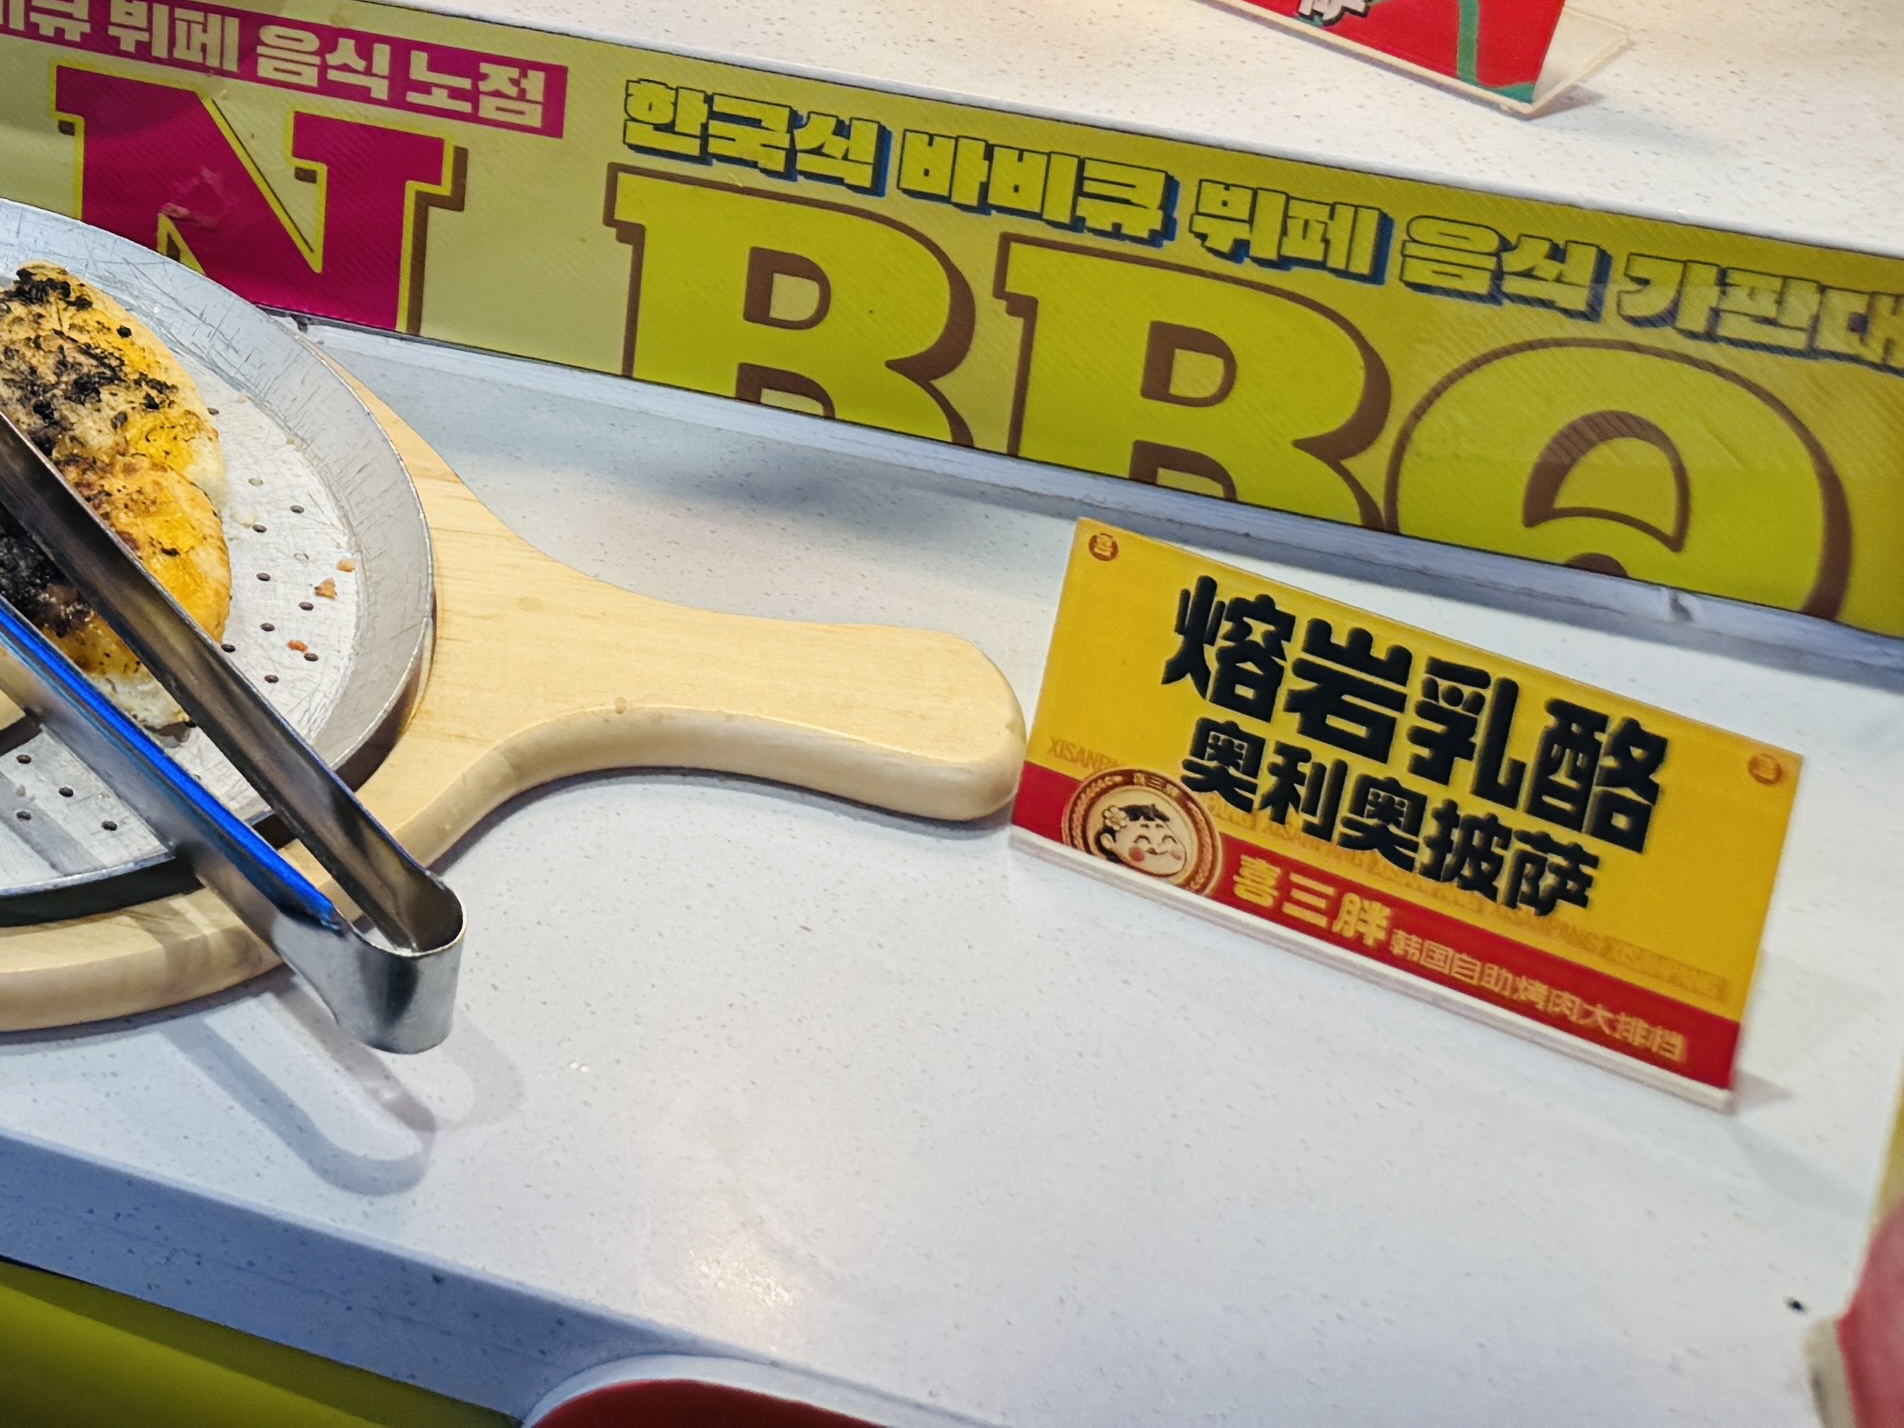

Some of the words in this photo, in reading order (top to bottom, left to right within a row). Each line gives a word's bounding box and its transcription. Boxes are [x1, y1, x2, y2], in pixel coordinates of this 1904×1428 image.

[255, 21, 393, 101] 음식
[405, 48, 548, 129] 노점
[623, 74, 895, 198] 한국식
[895, 124, 1182, 248] 바비큐
[1187, 174, 1395, 286] 뷔페
[1396, 212, 1612, 321] 음식
[1160, 574, 1671, 855] 熔岩乳酪
[1179, 718, 1602, 919] 奥利奥披萨
[1231, 853, 1391, 949] 喜三胖
[1389, 923, 1689, 1062] 韩国自助烤肉大排档
